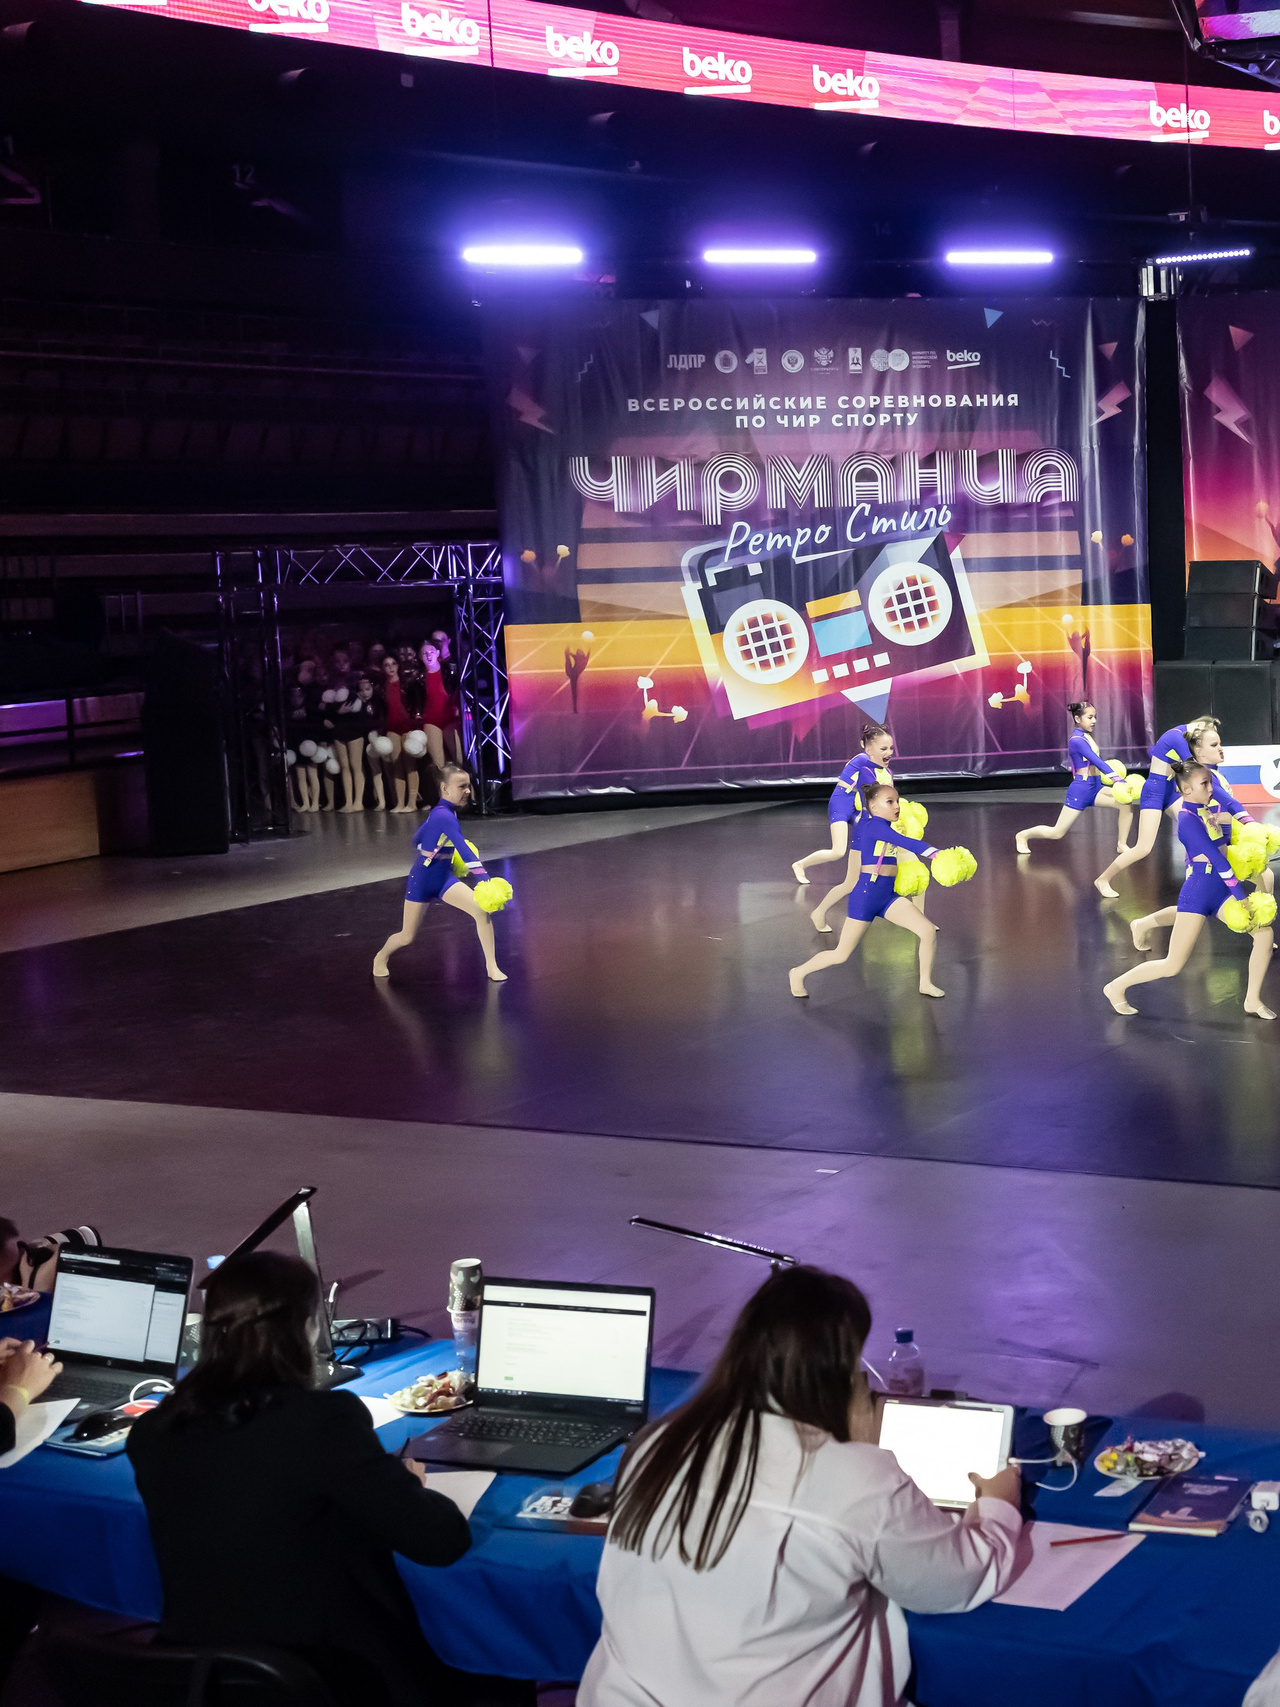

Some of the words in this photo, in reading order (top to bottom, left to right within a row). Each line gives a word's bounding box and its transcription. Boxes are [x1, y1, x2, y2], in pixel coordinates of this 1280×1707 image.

[401, 2, 480, 45] beko
[545, 25, 620, 66] beko
[682, 46, 753, 84] beko
[812, 64, 880, 99] beko
[1149, 100, 1211, 130] beko
[667, 353, 706, 371] ЛДПР
[946, 349, 981, 362] beko
[627, 394, 828, 412] ВСЕРОССИЙСКИЕ
[837, 393, 1020, 409] СОРЕВНОВАНИЯ
[735, 414, 766, 429] ПО
[776, 413, 821, 429] ЧИР
[831, 411, 920, 428] СПОРТУ
[724, 519, 832, 563] Ретро
[846, 502, 953, 544] Стиль
